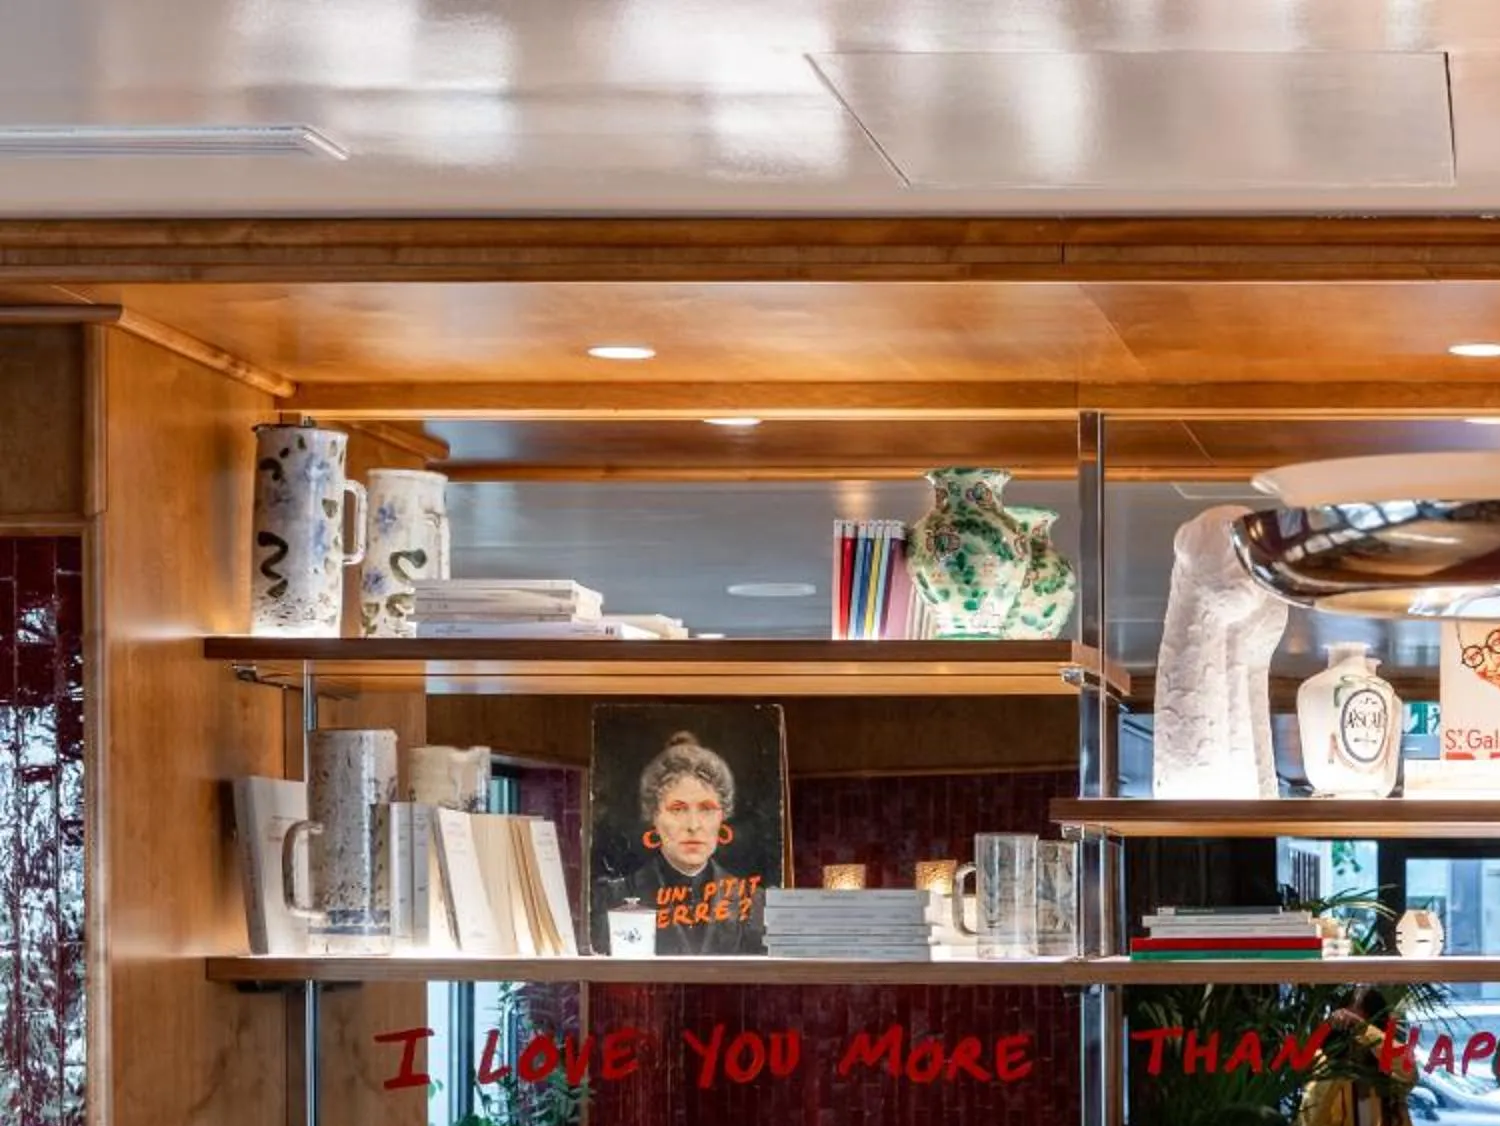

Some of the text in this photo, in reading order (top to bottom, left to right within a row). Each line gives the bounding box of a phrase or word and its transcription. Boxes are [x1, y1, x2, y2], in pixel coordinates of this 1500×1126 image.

[656, 886, 688, 905] UN
[373, 1027, 435, 1089] I
[477, 1028, 641, 1086] LOVE
[684, 1023, 802, 1087] YOU
[838, 1023, 1034, 1085] MORE
[1131, 1025, 1333, 1076] THAN
